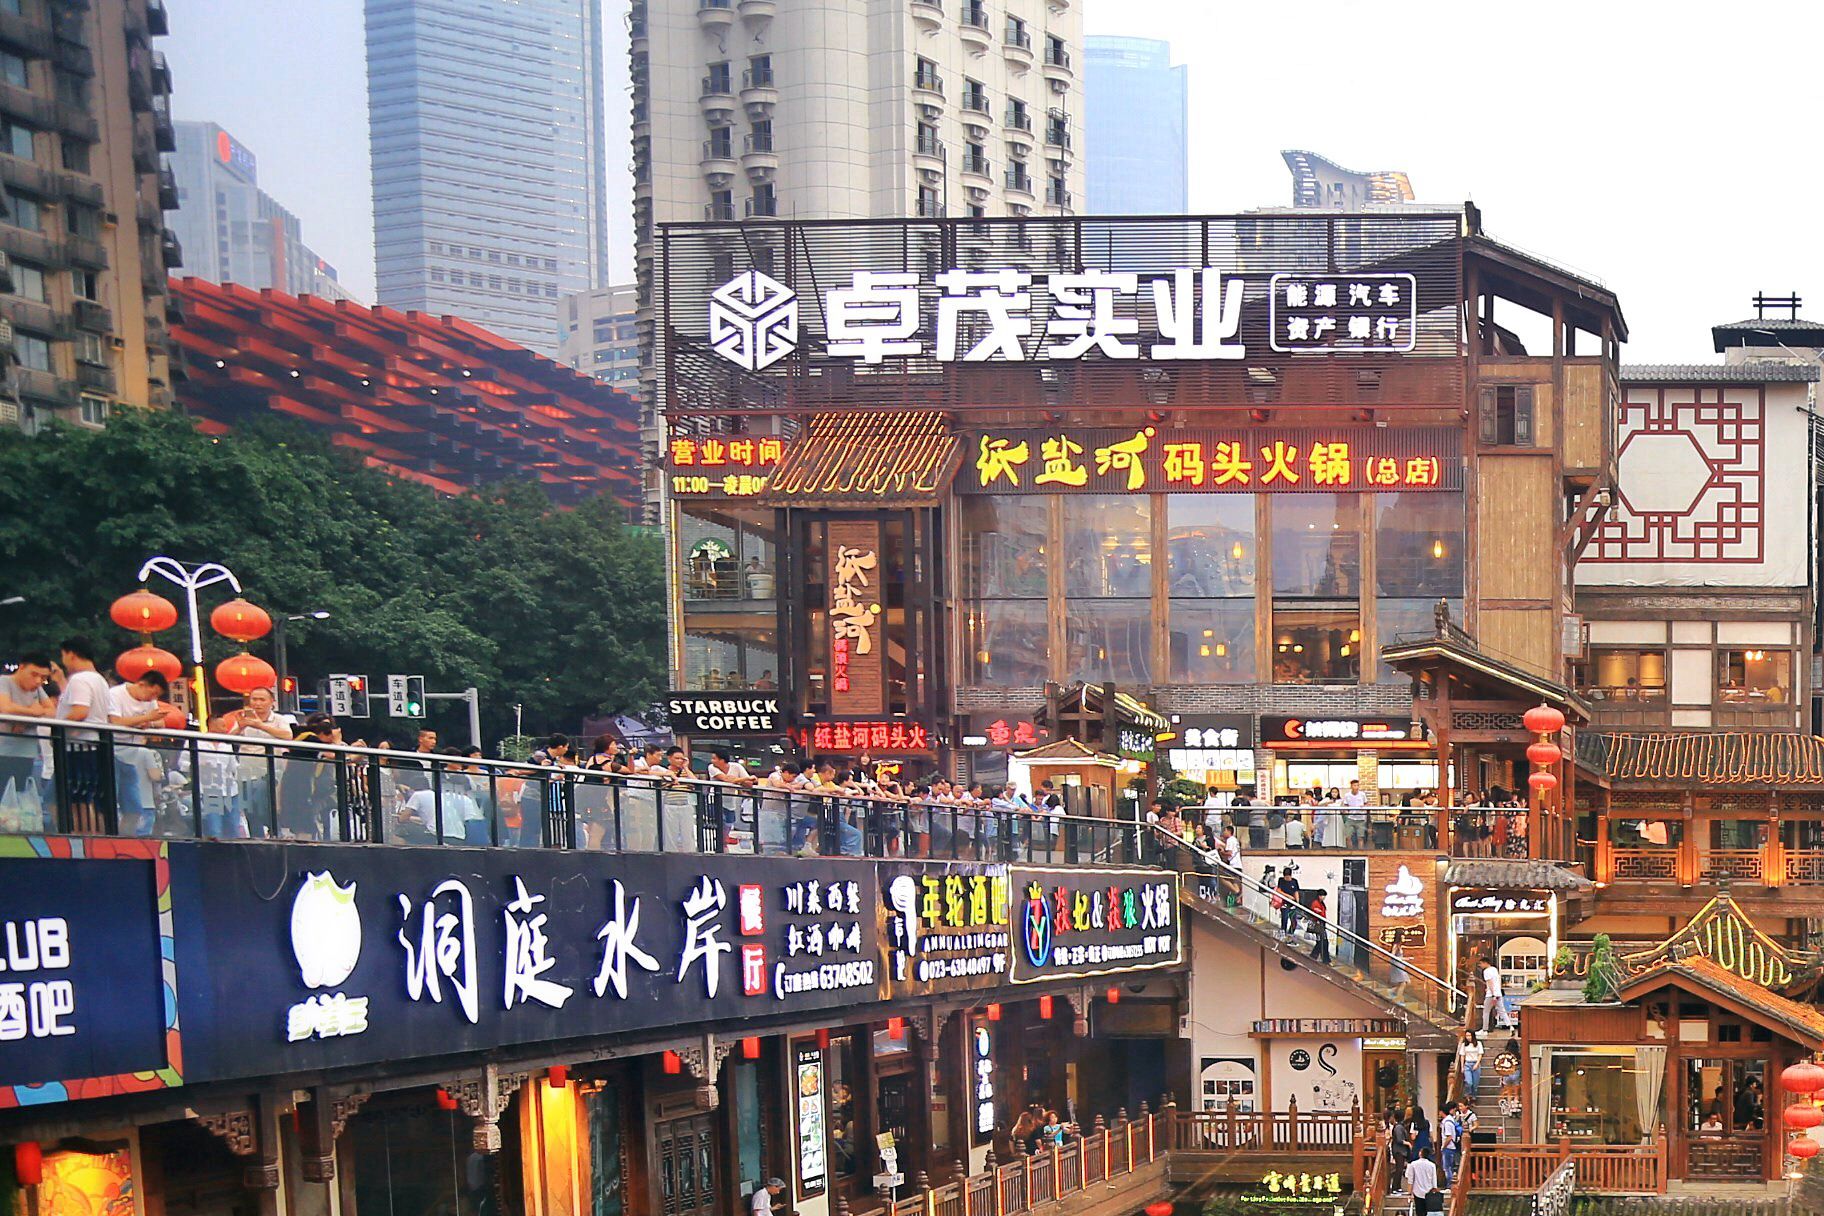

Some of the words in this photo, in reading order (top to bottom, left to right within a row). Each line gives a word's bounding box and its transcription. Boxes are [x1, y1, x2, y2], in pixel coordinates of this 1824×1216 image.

[825, 265, 1247, 364] 卓茂实业
[670, 438, 782, 466] 营业时间
[696, 715, 773, 730] COFFEE
[398, 873, 733, 1025] 洞庭水岸
